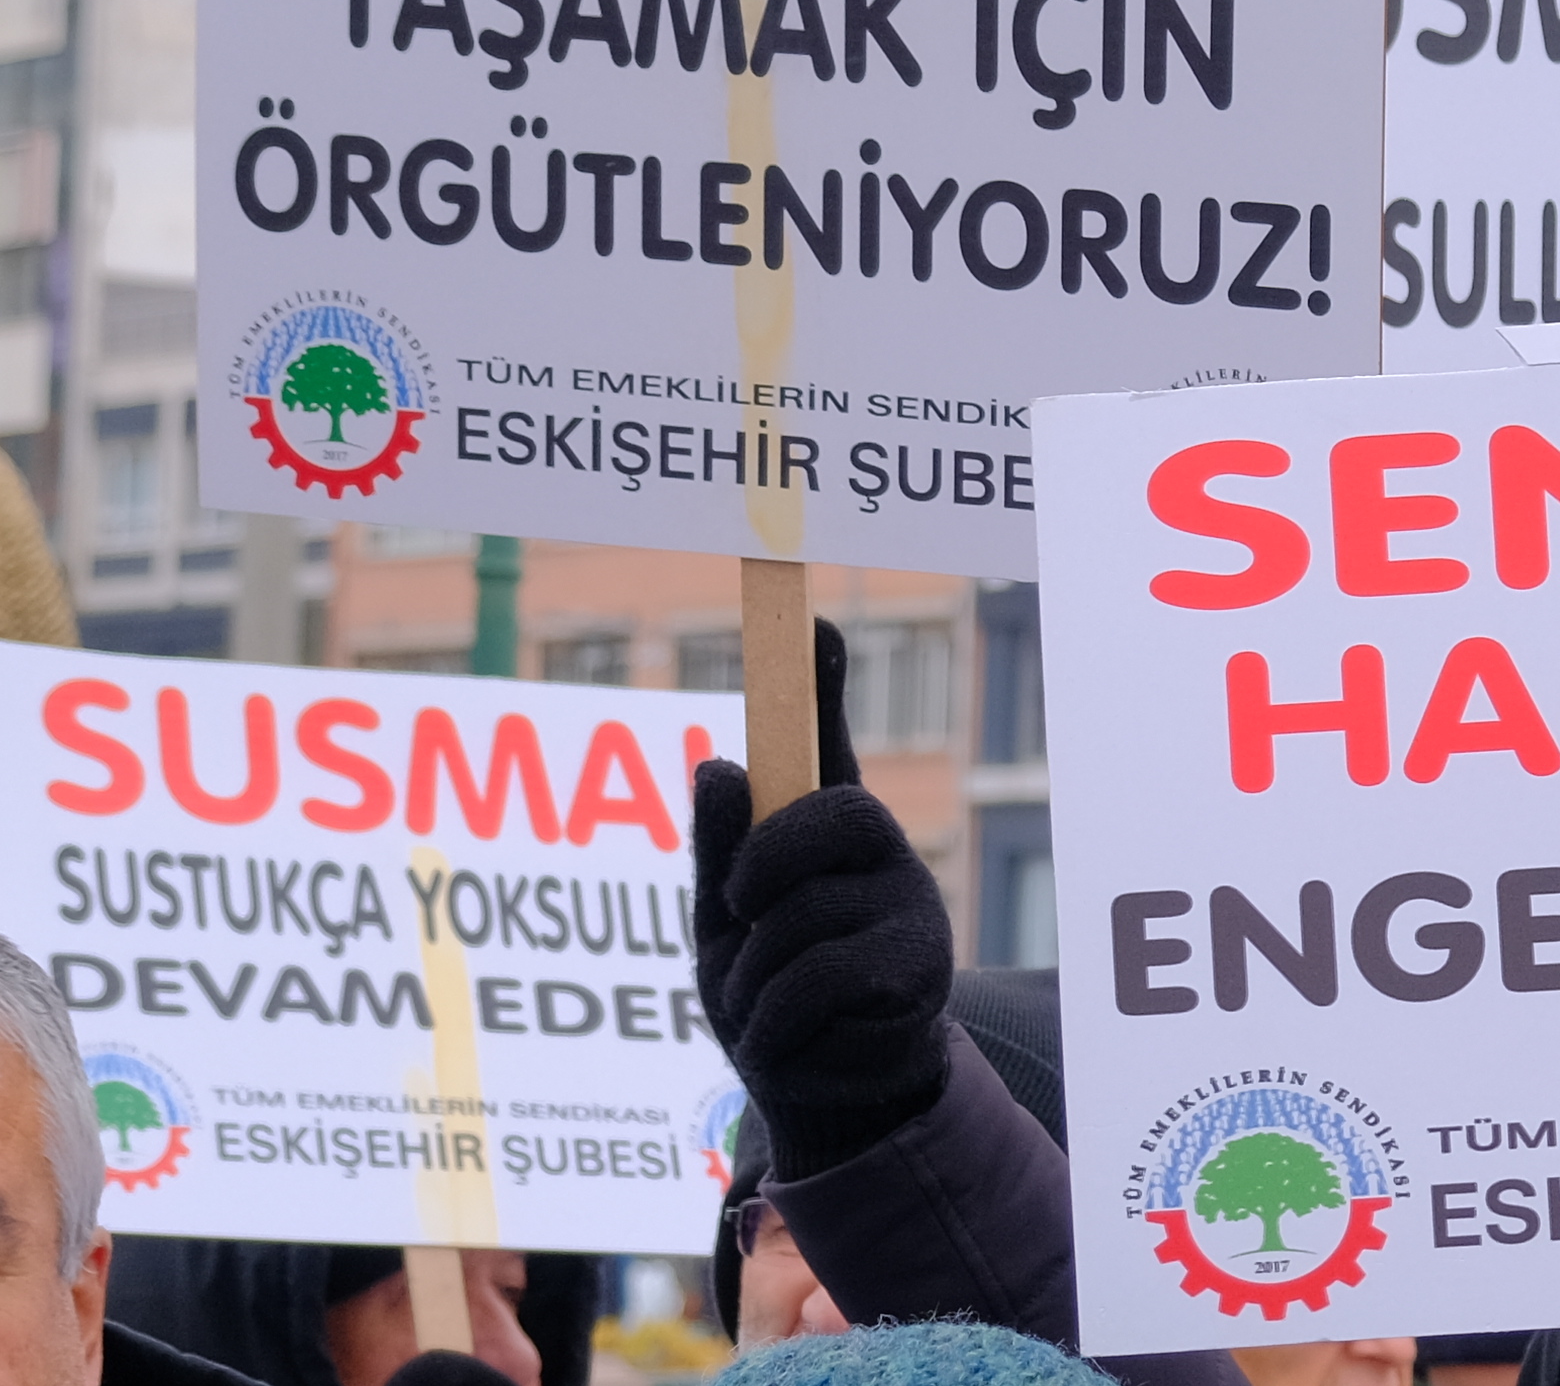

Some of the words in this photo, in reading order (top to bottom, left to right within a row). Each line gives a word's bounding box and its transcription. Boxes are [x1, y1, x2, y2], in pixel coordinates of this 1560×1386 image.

[234, 96, 1333, 317] ÖRGÜTLENİYORUZ!
[456, 358, 554, 390] TÜM
[572, 367, 850, 413] EMEKLİLERİN
[867, 393, 1030, 429] SENDİK
[456, 406, 821, 493] ESKİŞEHİR
[848, 441, 1035, 514] ŞUBE
[56, 845, 393, 957] SUSTUKÇA
[50, 952, 435, 1031] DEVAM
[212, 1085, 288, 1114] TÜM
[296, 1089, 498, 1119] EMEKLİLERİN
[509, 1099, 670, 1126] SENDİKASI
[1122, 1164, 1147, 1219] TÜM
[1140, 1066, 1308, 1153] EMEKLİLERİN
[1319, 1081, 1411, 1199] SENDİKASI
[1428, 1115, 1560, 1158] TÜM
[216, 1120, 485, 1186] ESKİŞEHİR
[503, 1133, 682, 1185] ŞUBESİ
[1254, 1260, 1290, 1274] 2017
